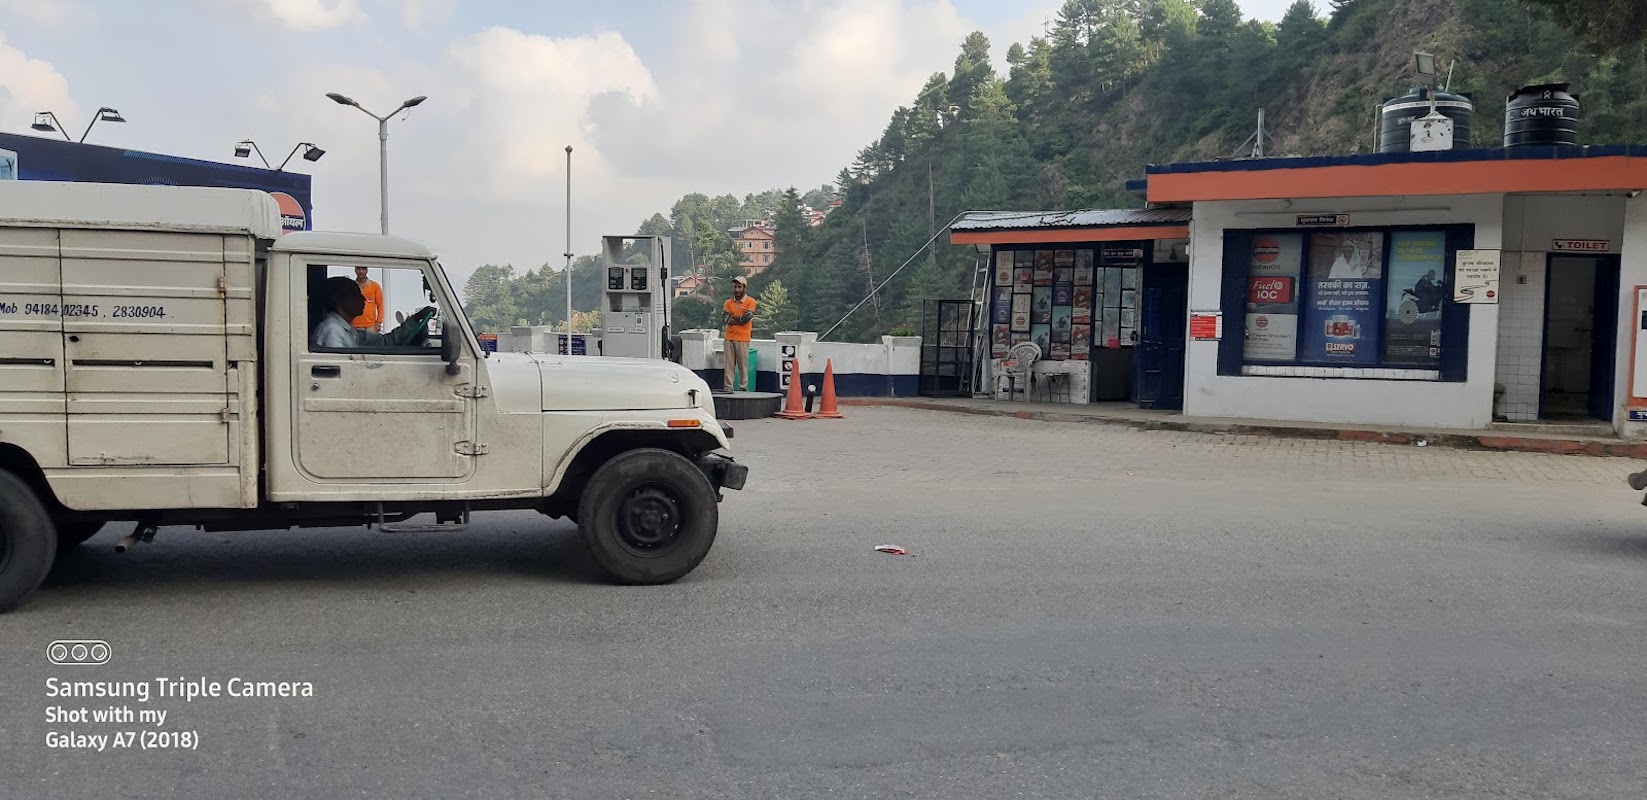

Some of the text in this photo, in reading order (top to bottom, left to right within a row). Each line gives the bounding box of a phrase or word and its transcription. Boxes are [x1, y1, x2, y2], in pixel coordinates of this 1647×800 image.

[1539, 107, 1564, 117] भारत
[1566, 241, 1608, 249] TOILET
[1317, 279, 1342, 290] तरक्की
[1342, 281, 1353, 289] का
[1257, 290, 1278, 299] IOC
[112, 305, 167, 319] 2830904
[1331, 343, 1355, 351] SERVO
